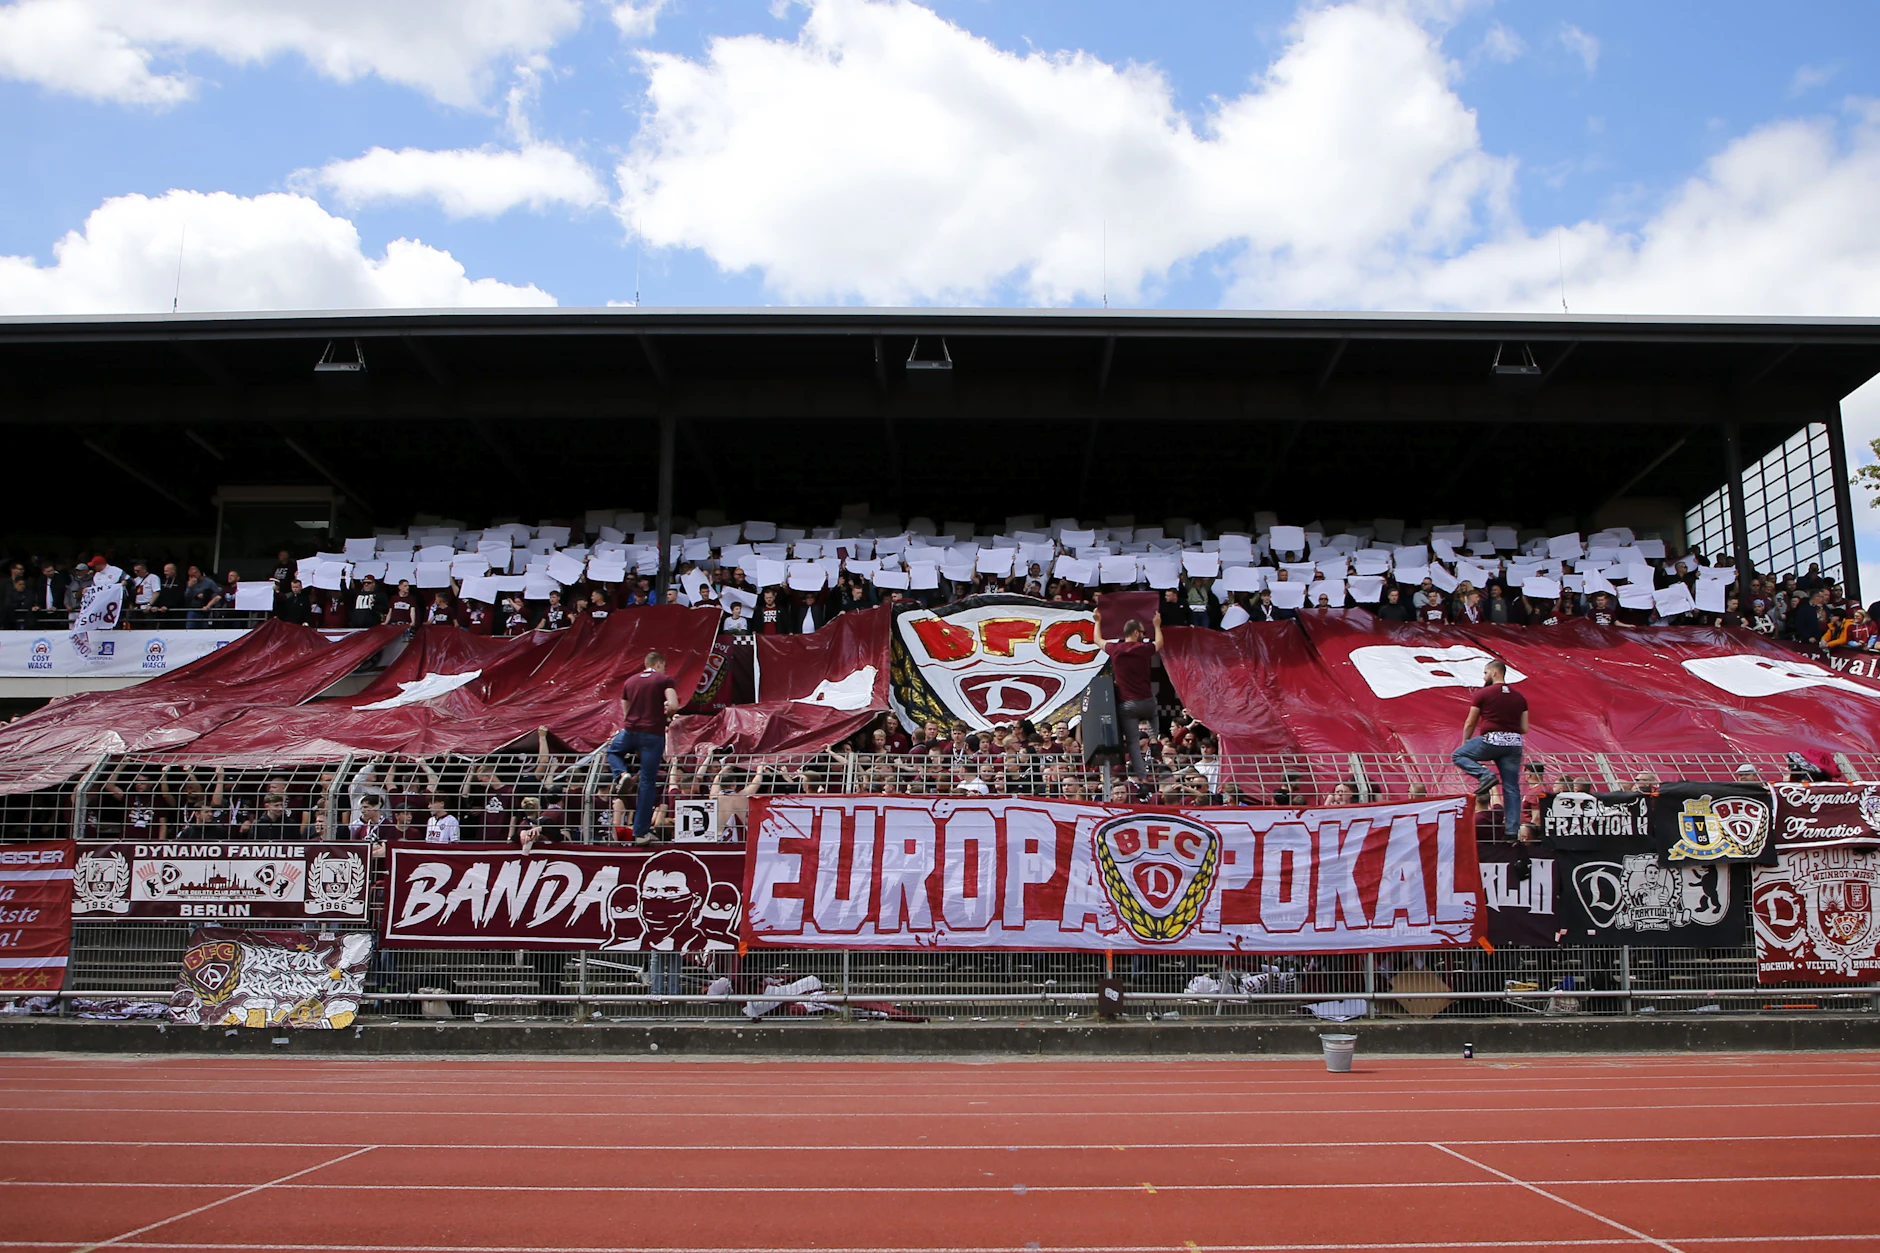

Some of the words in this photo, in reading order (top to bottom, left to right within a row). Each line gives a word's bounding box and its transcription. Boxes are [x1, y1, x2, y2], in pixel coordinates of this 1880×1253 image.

[909, 616, 1101, 664] BFC
[1830, 656, 1880, 680] wal
[1715, 802, 1759, 819] BFC
[1544, 816, 1633, 836] FRAKTION
[1637, 816, 1648, 835] H
[1782, 816, 1863, 839] Fanatico
[134, 845, 222, 857] DYNAMO
[227, 846, 305, 857] FAMILIE
[1113, 825, 1202, 860] BFC
[0, 850, 65, 865] EISTER
[749, 806, 1118, 934] EUROPA
[1199, 810, 1476, 933] POKAL
[393, 857, 620, 933] BANDA
[85, 902, 114, 910] 1954
[180, 904, 250, 917] BERLIN
[320, 902, 347, 911] 1966
[184, 943, 235, 970] BFC
[1760, 961, 1795, 971] BOCHUM
[1805, 961, 1837, 970] VELTEN
